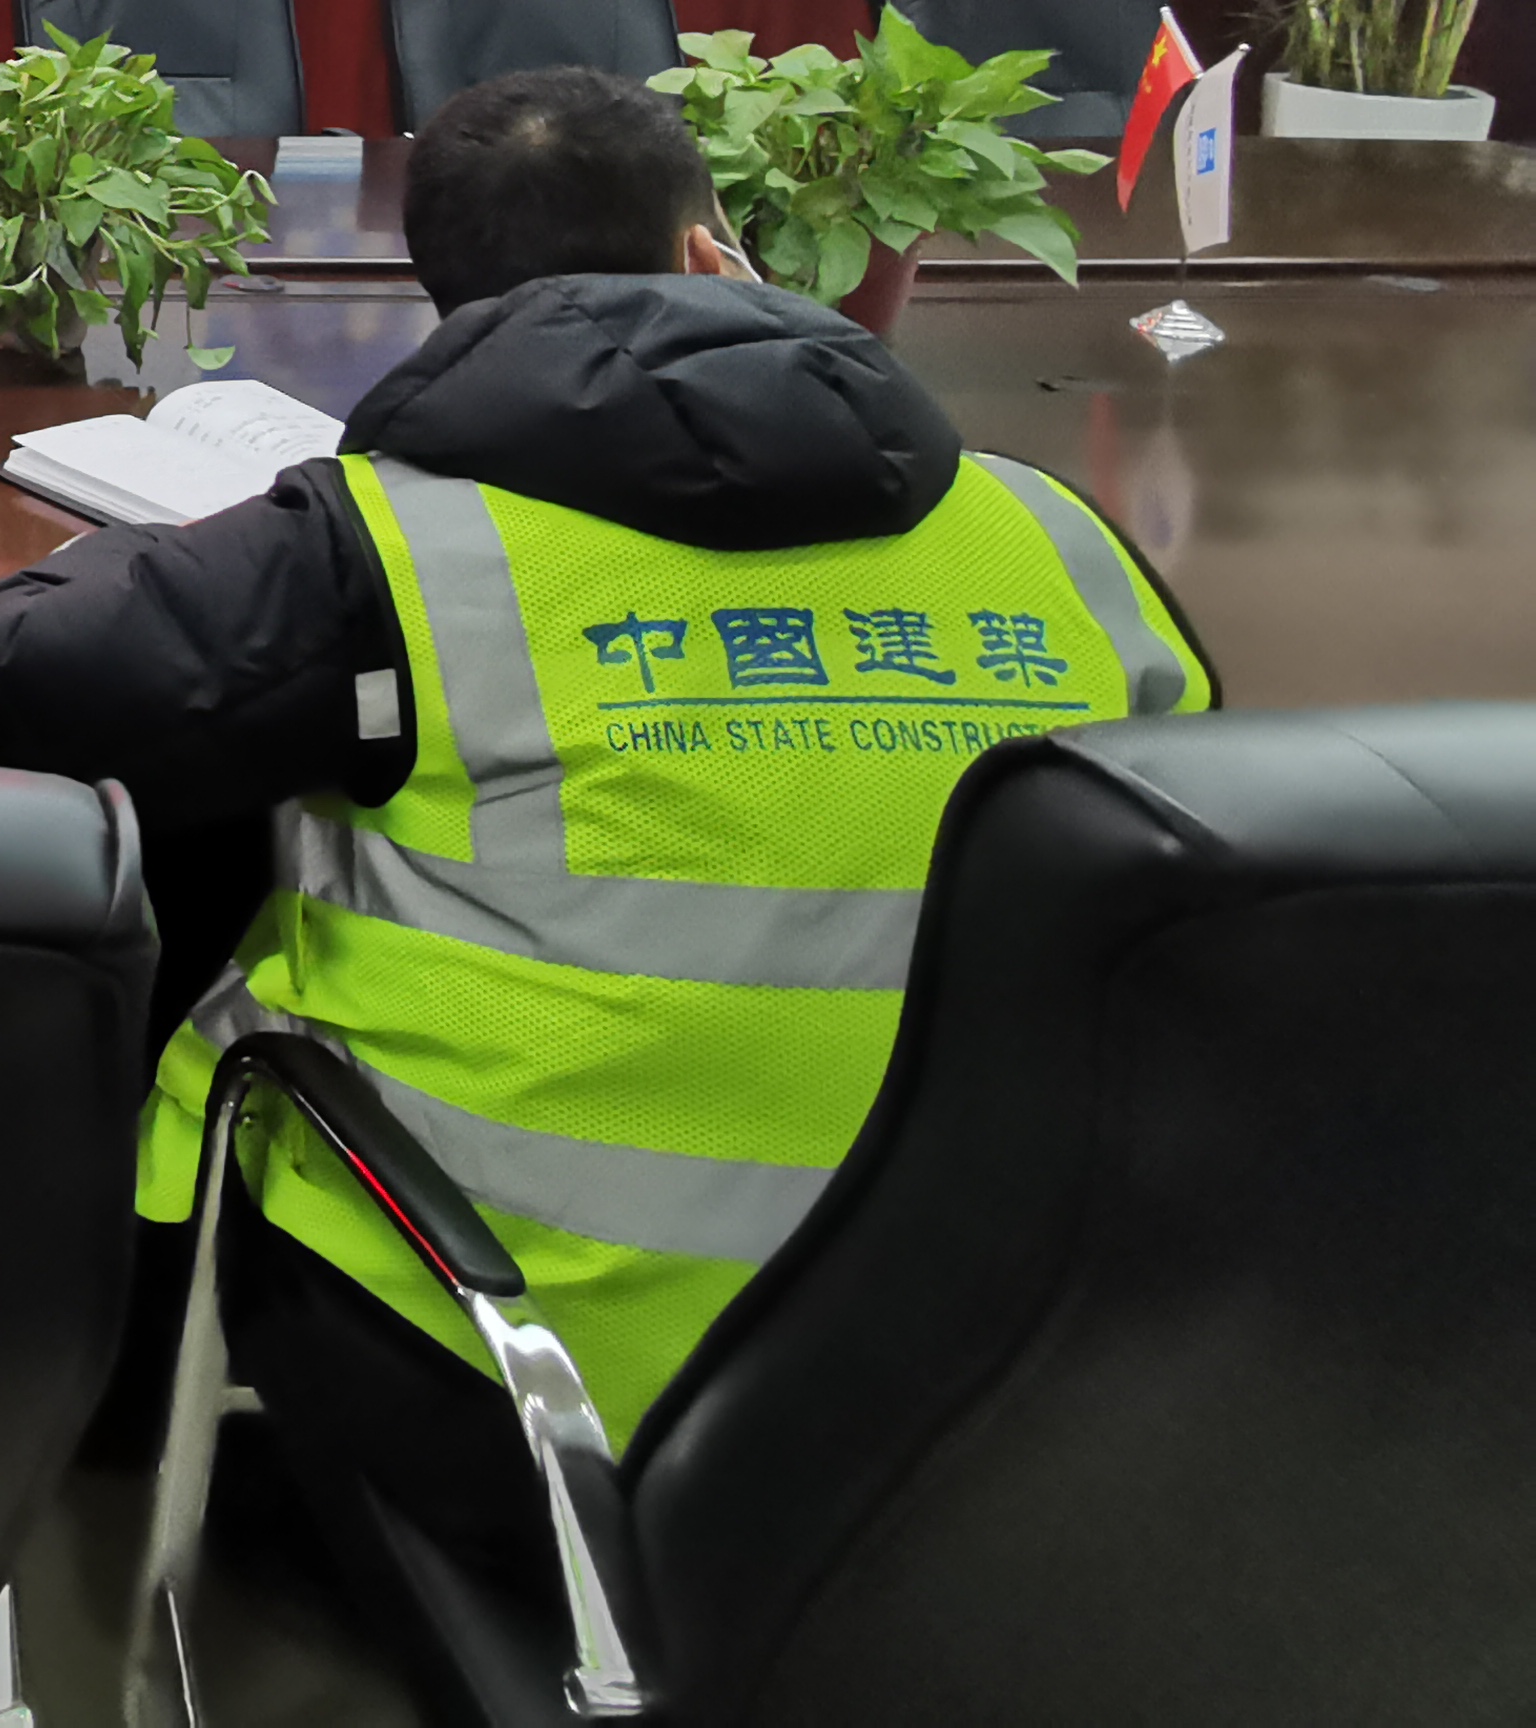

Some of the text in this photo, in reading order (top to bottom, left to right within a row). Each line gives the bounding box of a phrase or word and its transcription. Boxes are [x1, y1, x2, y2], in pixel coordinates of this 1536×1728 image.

[581, 607, 1069, 695] 中國建築
[605, 719, 712, 754] CHINA
[727, 717, 836, 752] STATE
